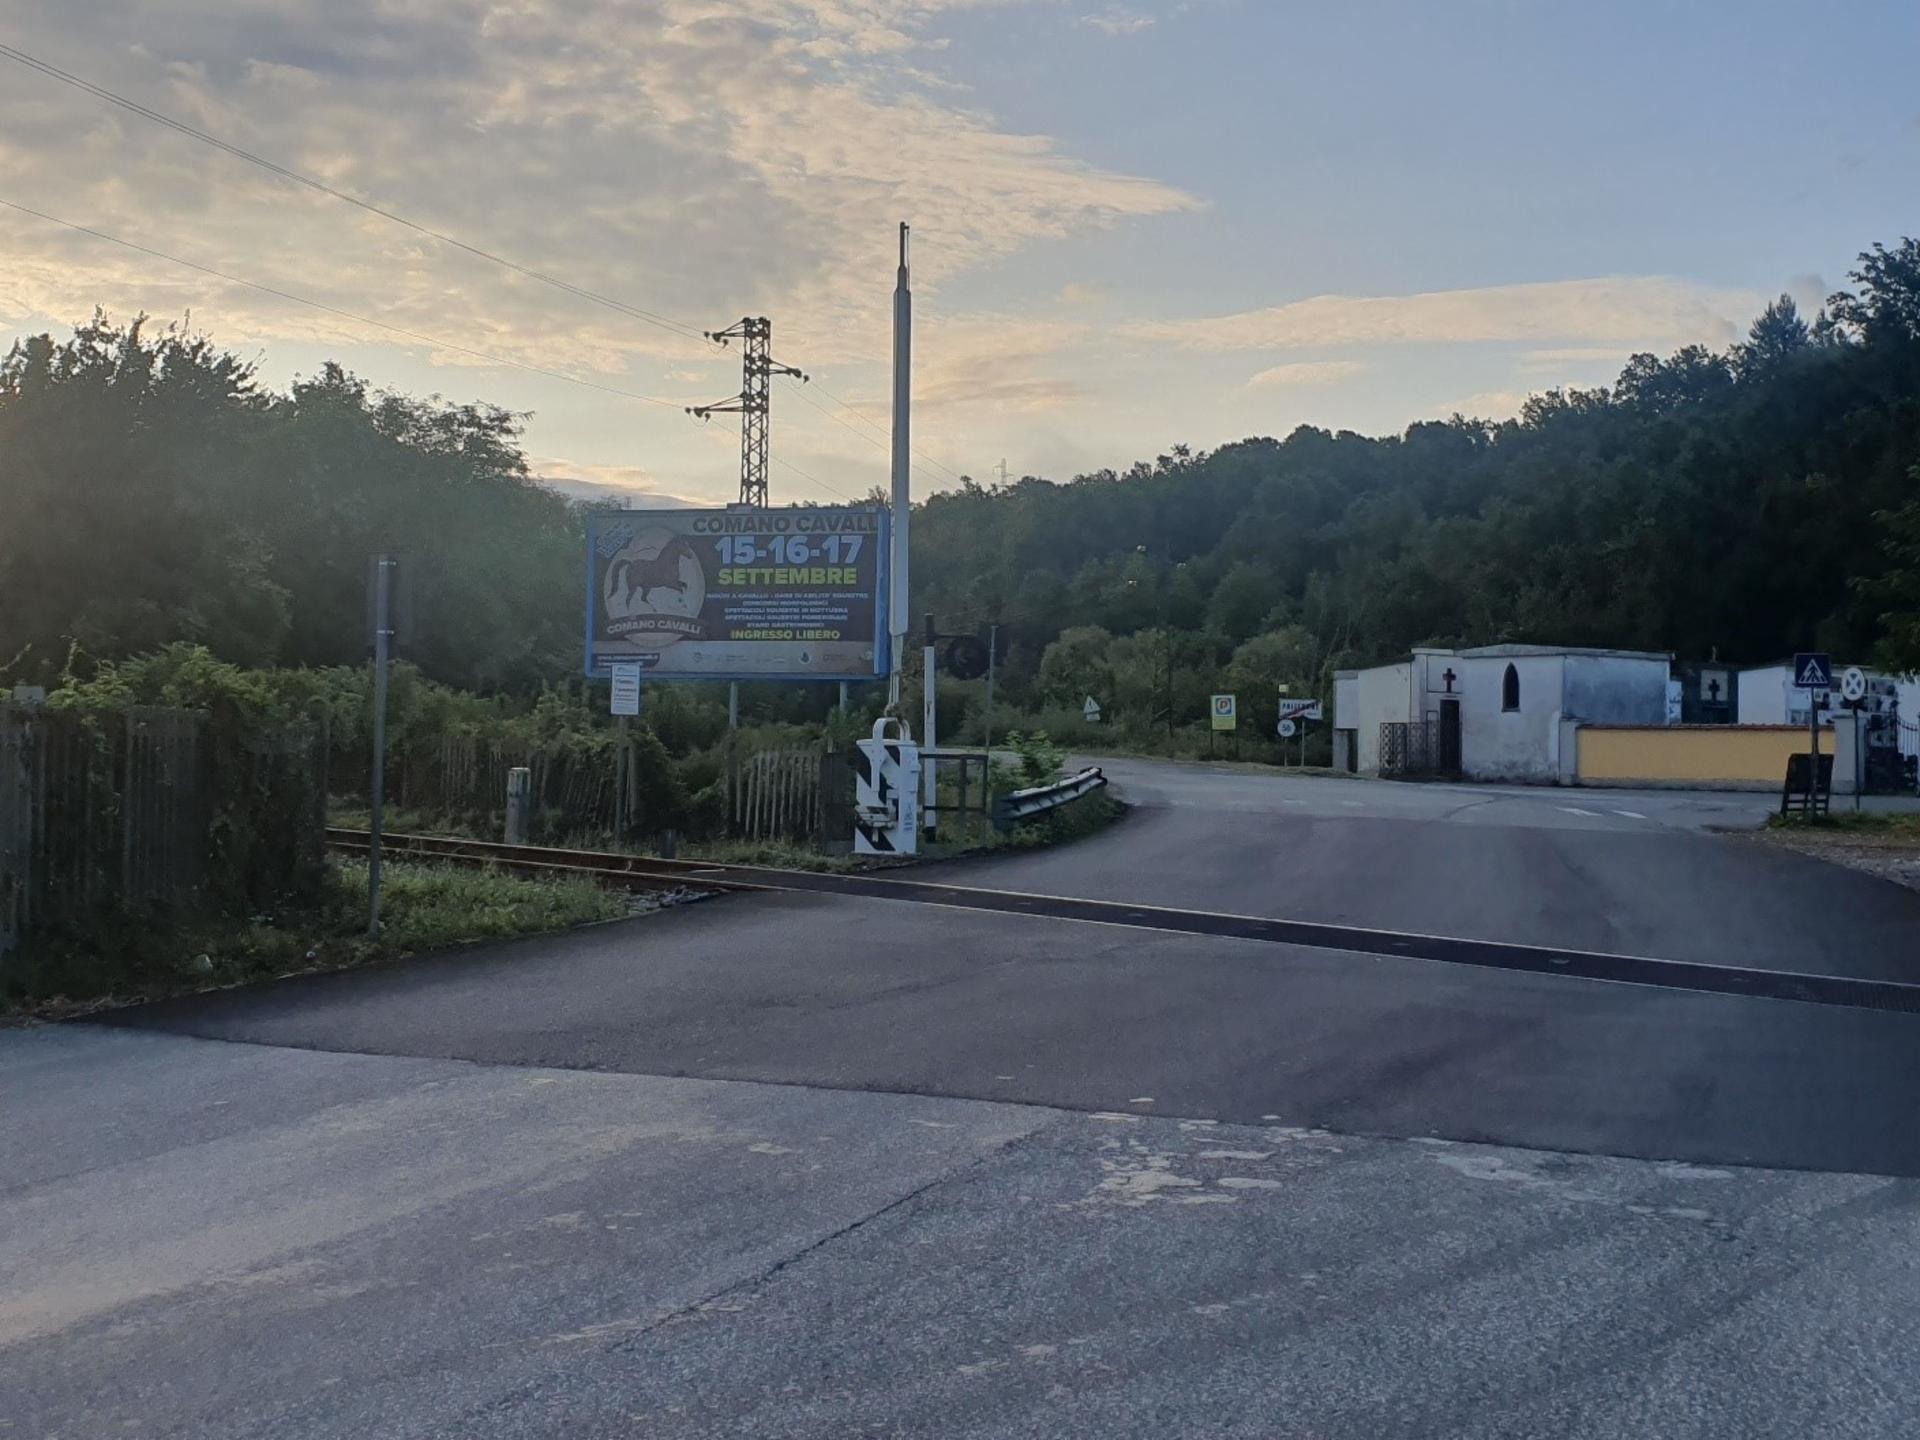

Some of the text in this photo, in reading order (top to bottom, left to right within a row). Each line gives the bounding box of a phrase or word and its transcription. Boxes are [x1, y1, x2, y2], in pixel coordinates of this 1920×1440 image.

[693, 516, 879, 533] COMANO CAVALL
[715, 535, 863, 564] 15-16-17
[718, 567, 857, 585] SETTEMBRE
[607, 619, 701, 635] COMANO CAVALLI
[730, 630, 841, 640] INGRESSO LIBERO
